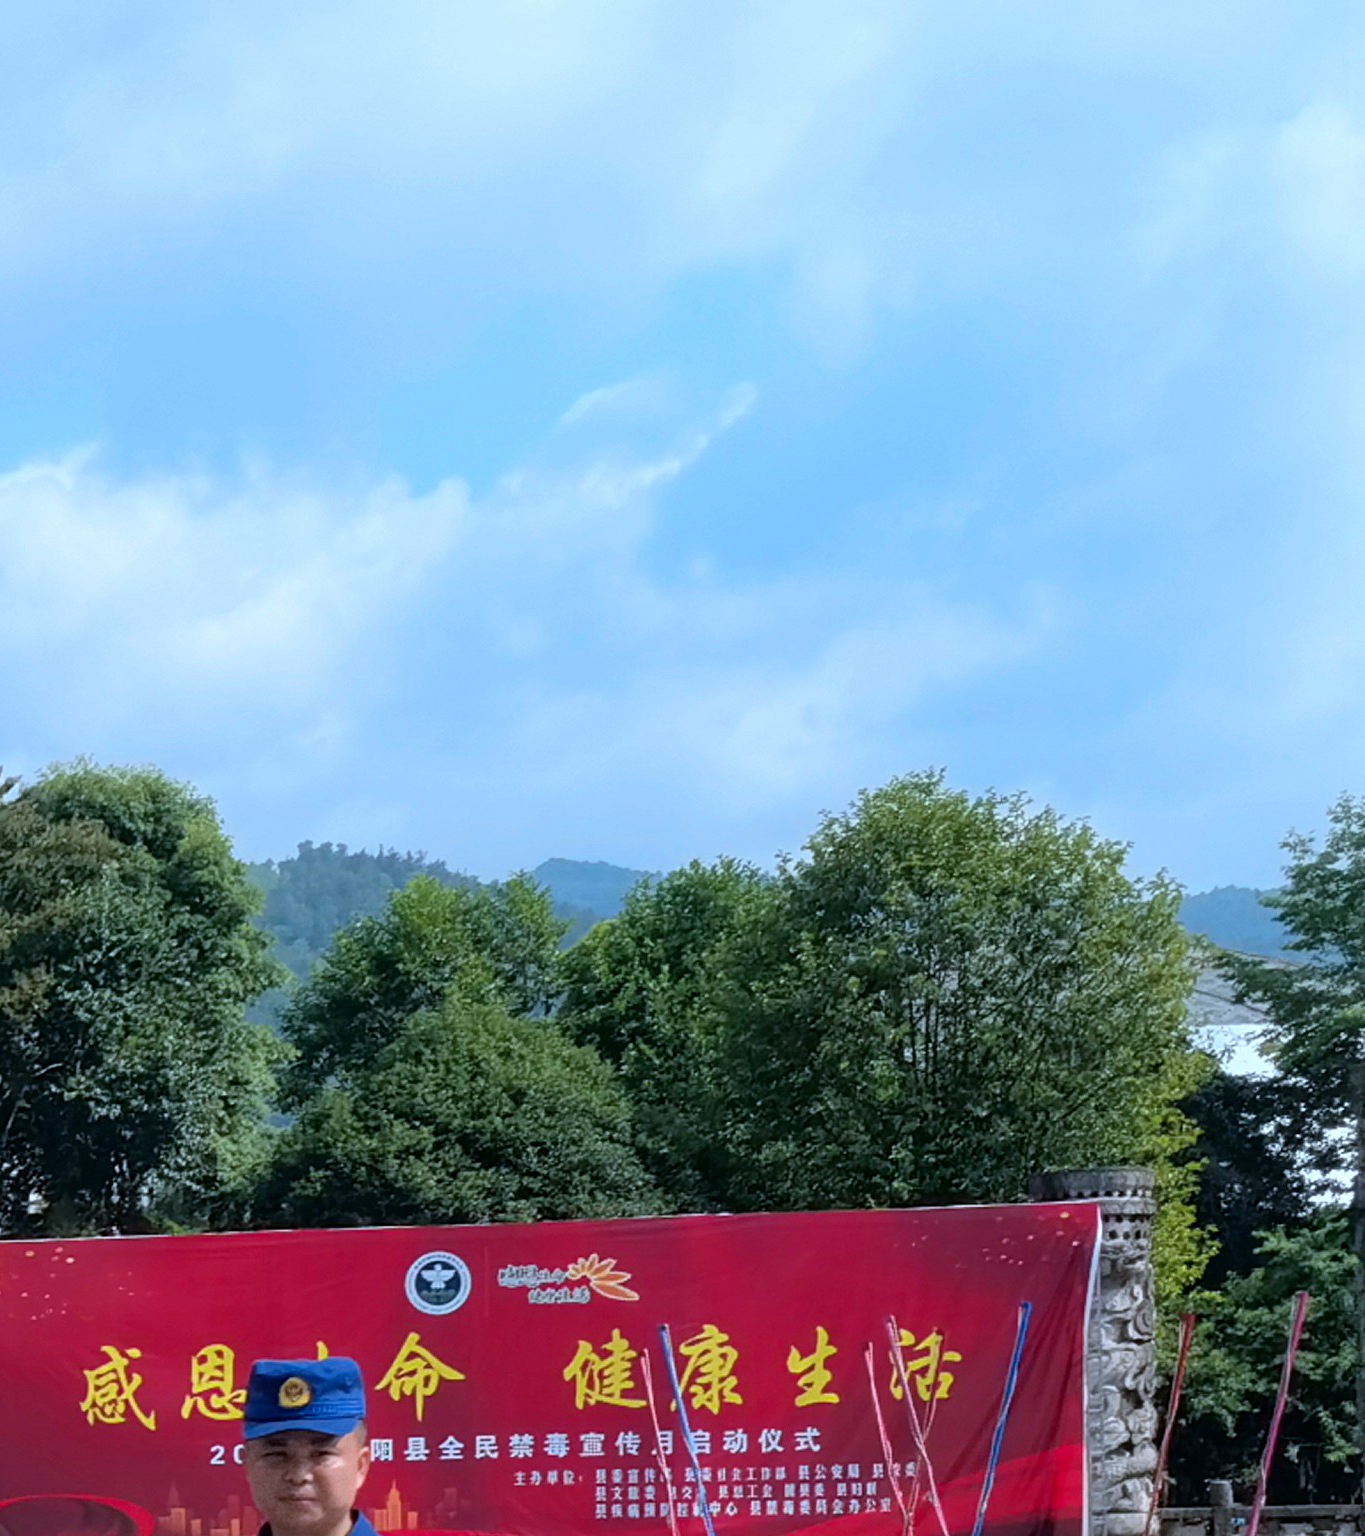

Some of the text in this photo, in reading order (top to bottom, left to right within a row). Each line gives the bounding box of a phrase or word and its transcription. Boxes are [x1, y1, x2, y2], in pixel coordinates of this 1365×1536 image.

[78, 1323, 963, 1431] 感恩命 健康生活
[209, 1427, 822, 1466] 20阳县全民禁毒宣传月启动仪式
